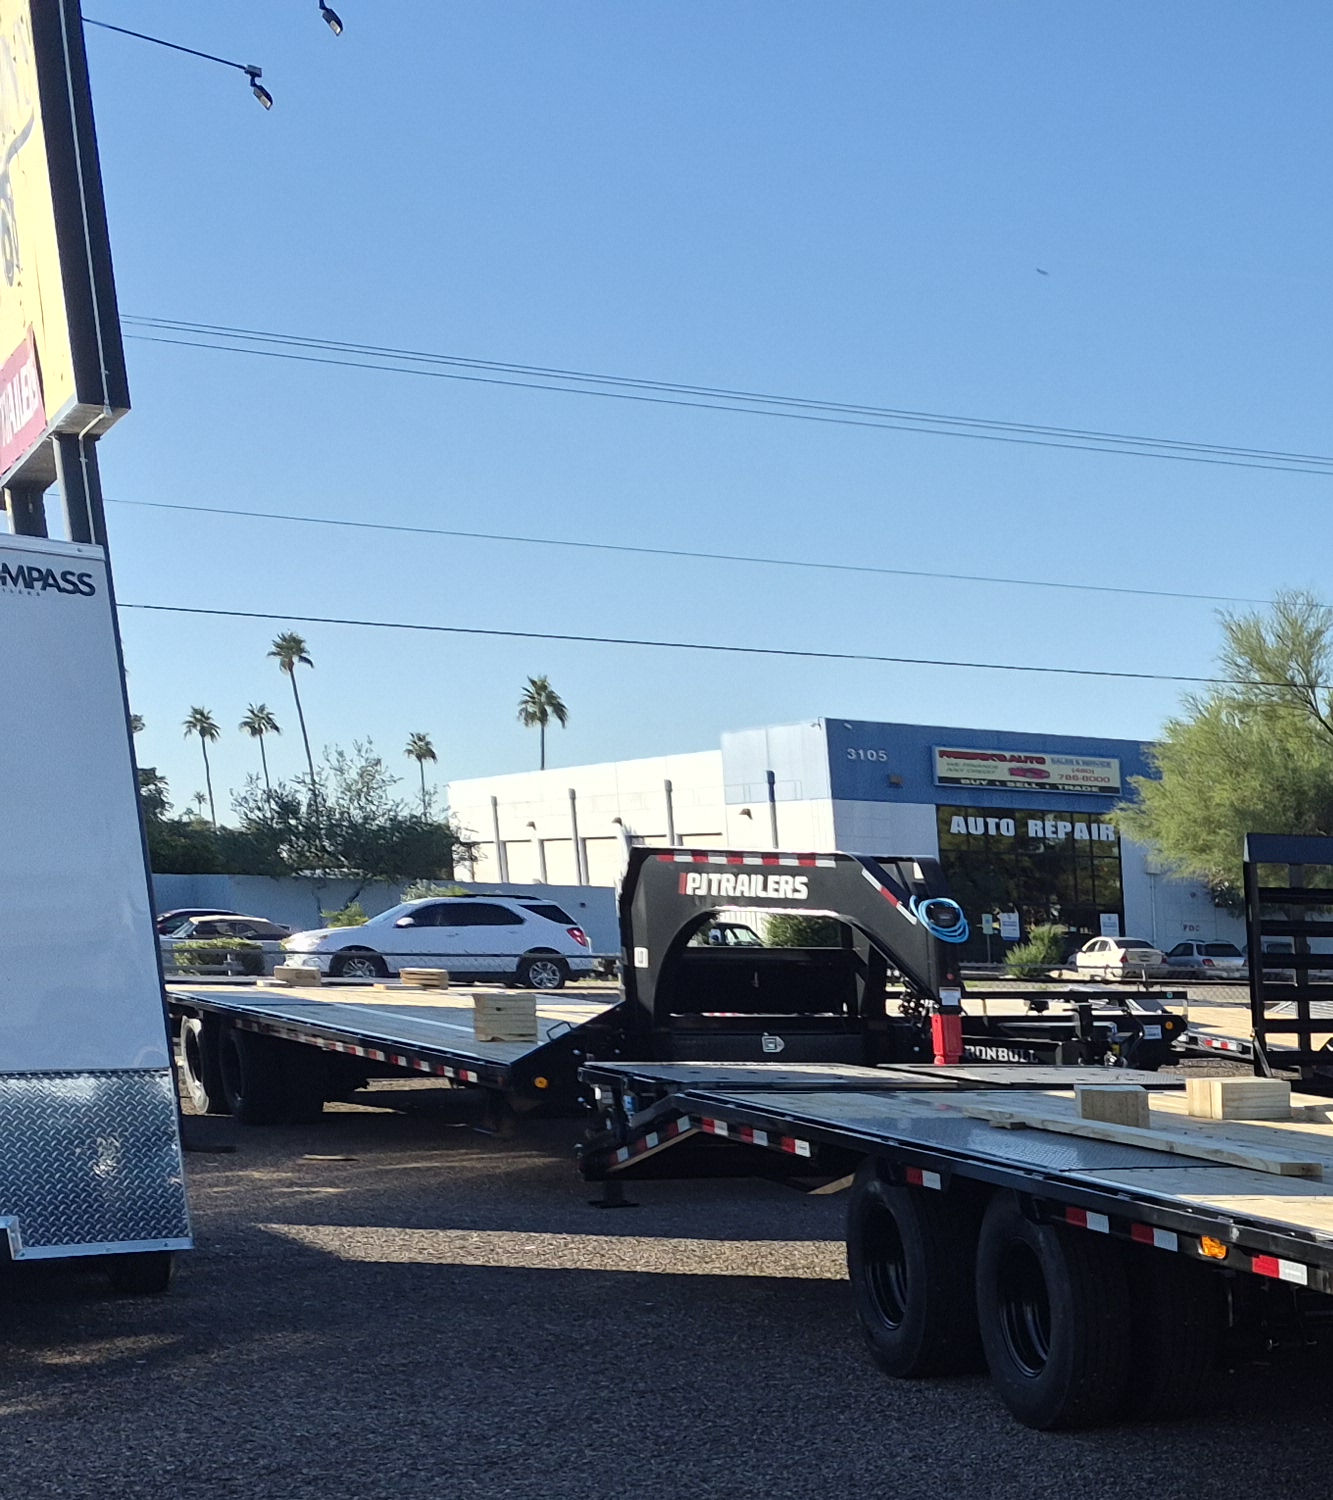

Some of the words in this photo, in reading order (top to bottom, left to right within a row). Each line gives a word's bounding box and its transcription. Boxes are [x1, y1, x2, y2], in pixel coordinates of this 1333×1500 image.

[0, 562, 96, 597] MPASS
[846, 748, 888, 762] 3105
[960, 778, 989, 786] BUY
[1006, 781, 1040, 789] SELL
[1056, 784, 1100, 793] TRADE
[950, 815, 1016, 837] AUTO
[1027, 819, 1116, 842] REPAIR
[963, 1045, 1039, 1063] RONBULL
